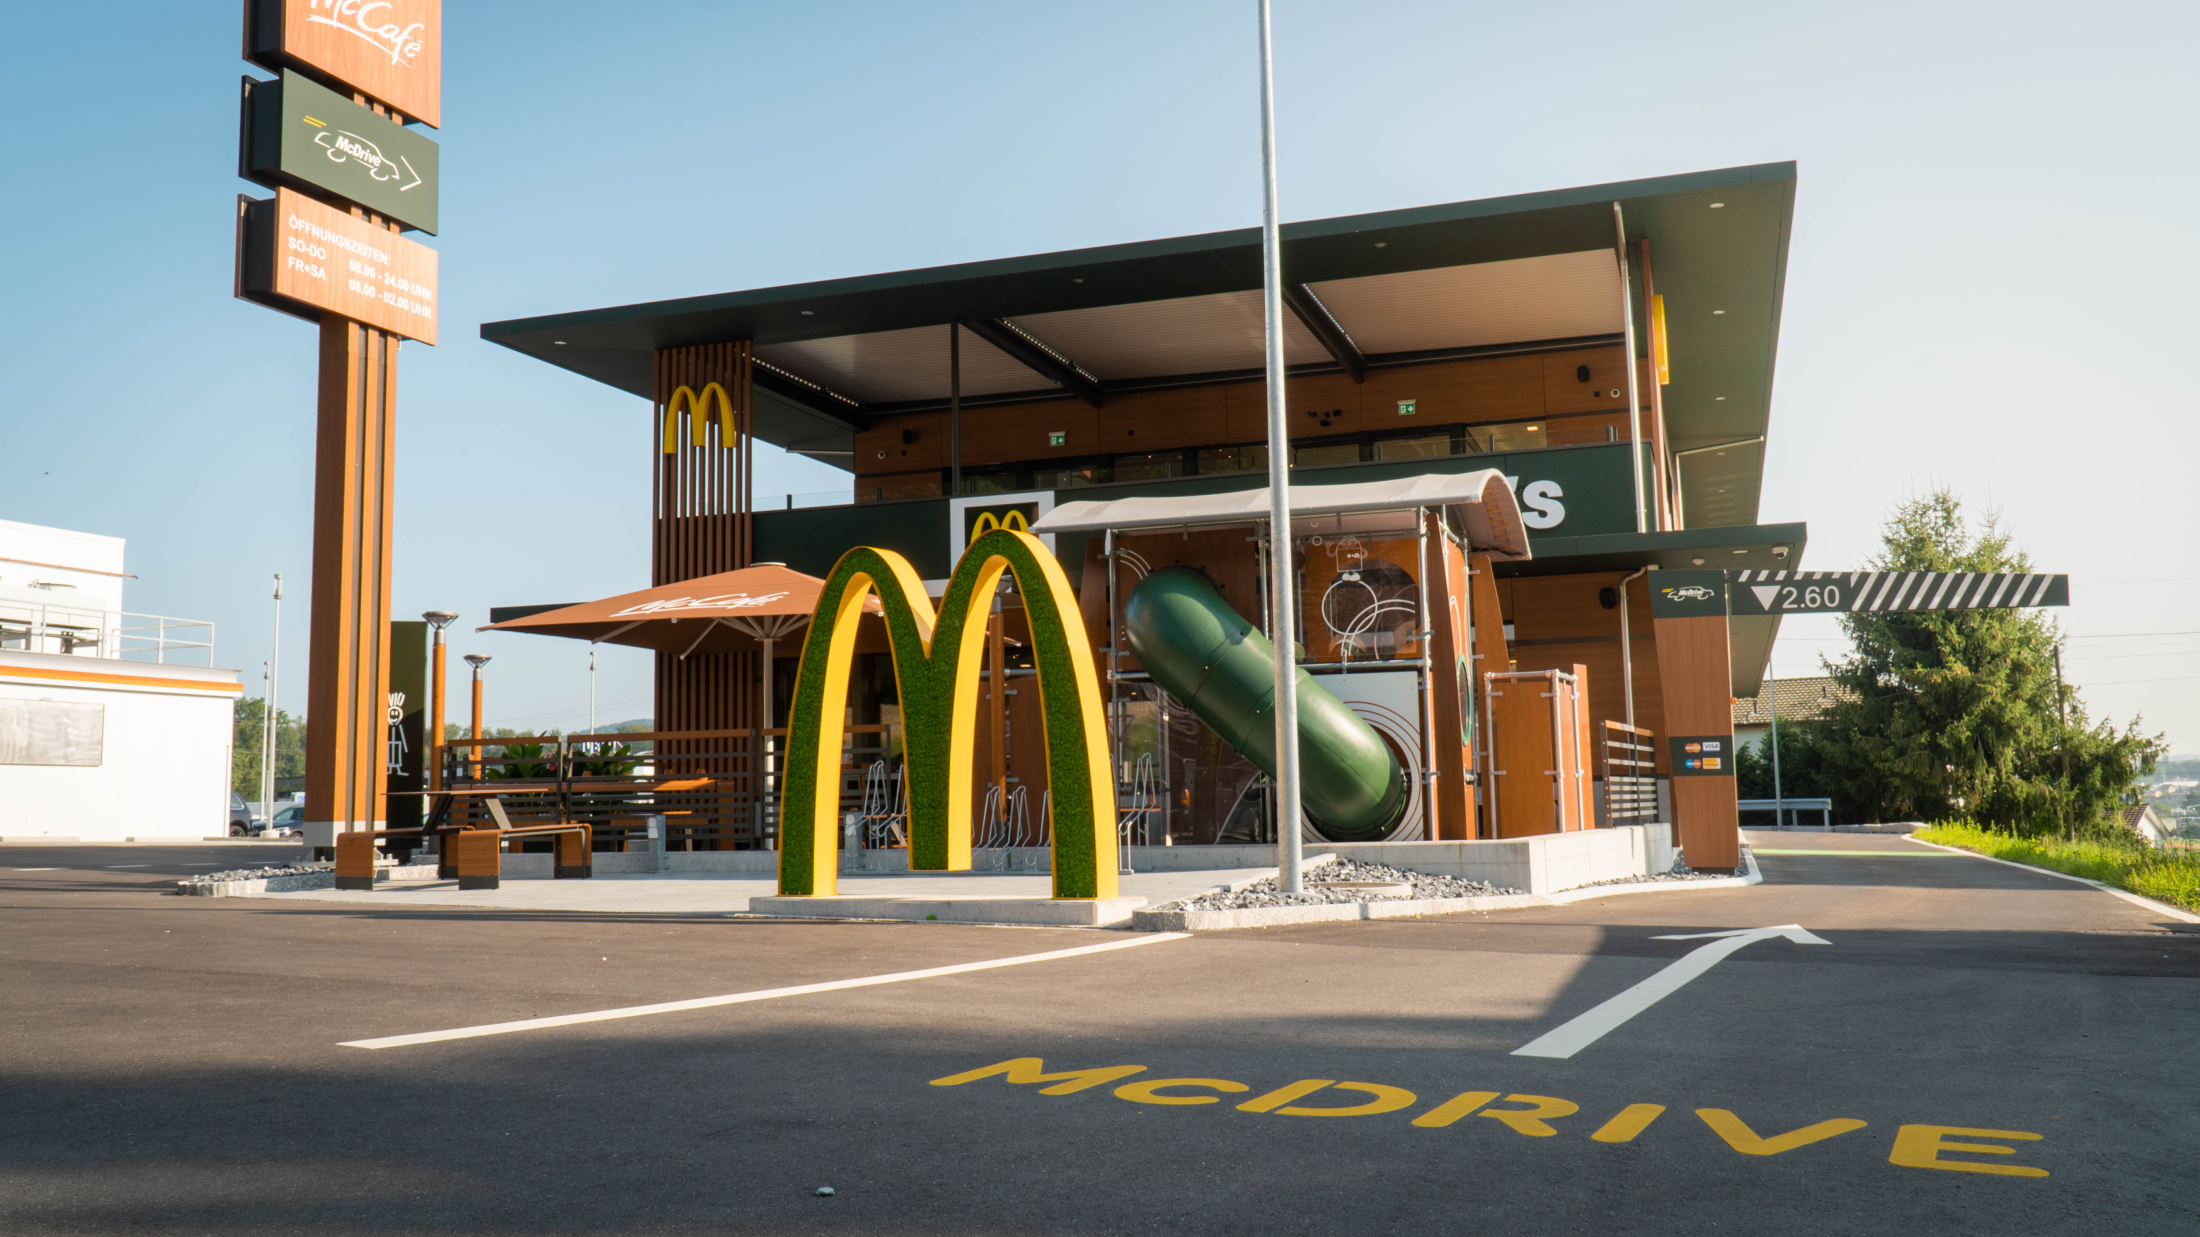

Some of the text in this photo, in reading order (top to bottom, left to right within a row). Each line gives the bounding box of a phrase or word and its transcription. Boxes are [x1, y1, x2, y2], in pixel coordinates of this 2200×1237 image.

[335, 135, 382, 167] McDrive
[288, 213, 391, 266] ÖFFNUNGSZEITEN:
[288, 236, 327, 260] SO-DO
[349, 259, 376, 280] 08.00
[384, 272, 409, 292] 24.00
[411, 283, 432, 301] UHR
[288, 256, 327, 281] FR+SA
[349, 278, 376, 299] 08.00
[384, 291, 409, 311] 02.00
[411, 301, 432, 319] UHR
[1782, 585, 1840, 609] 2.60
